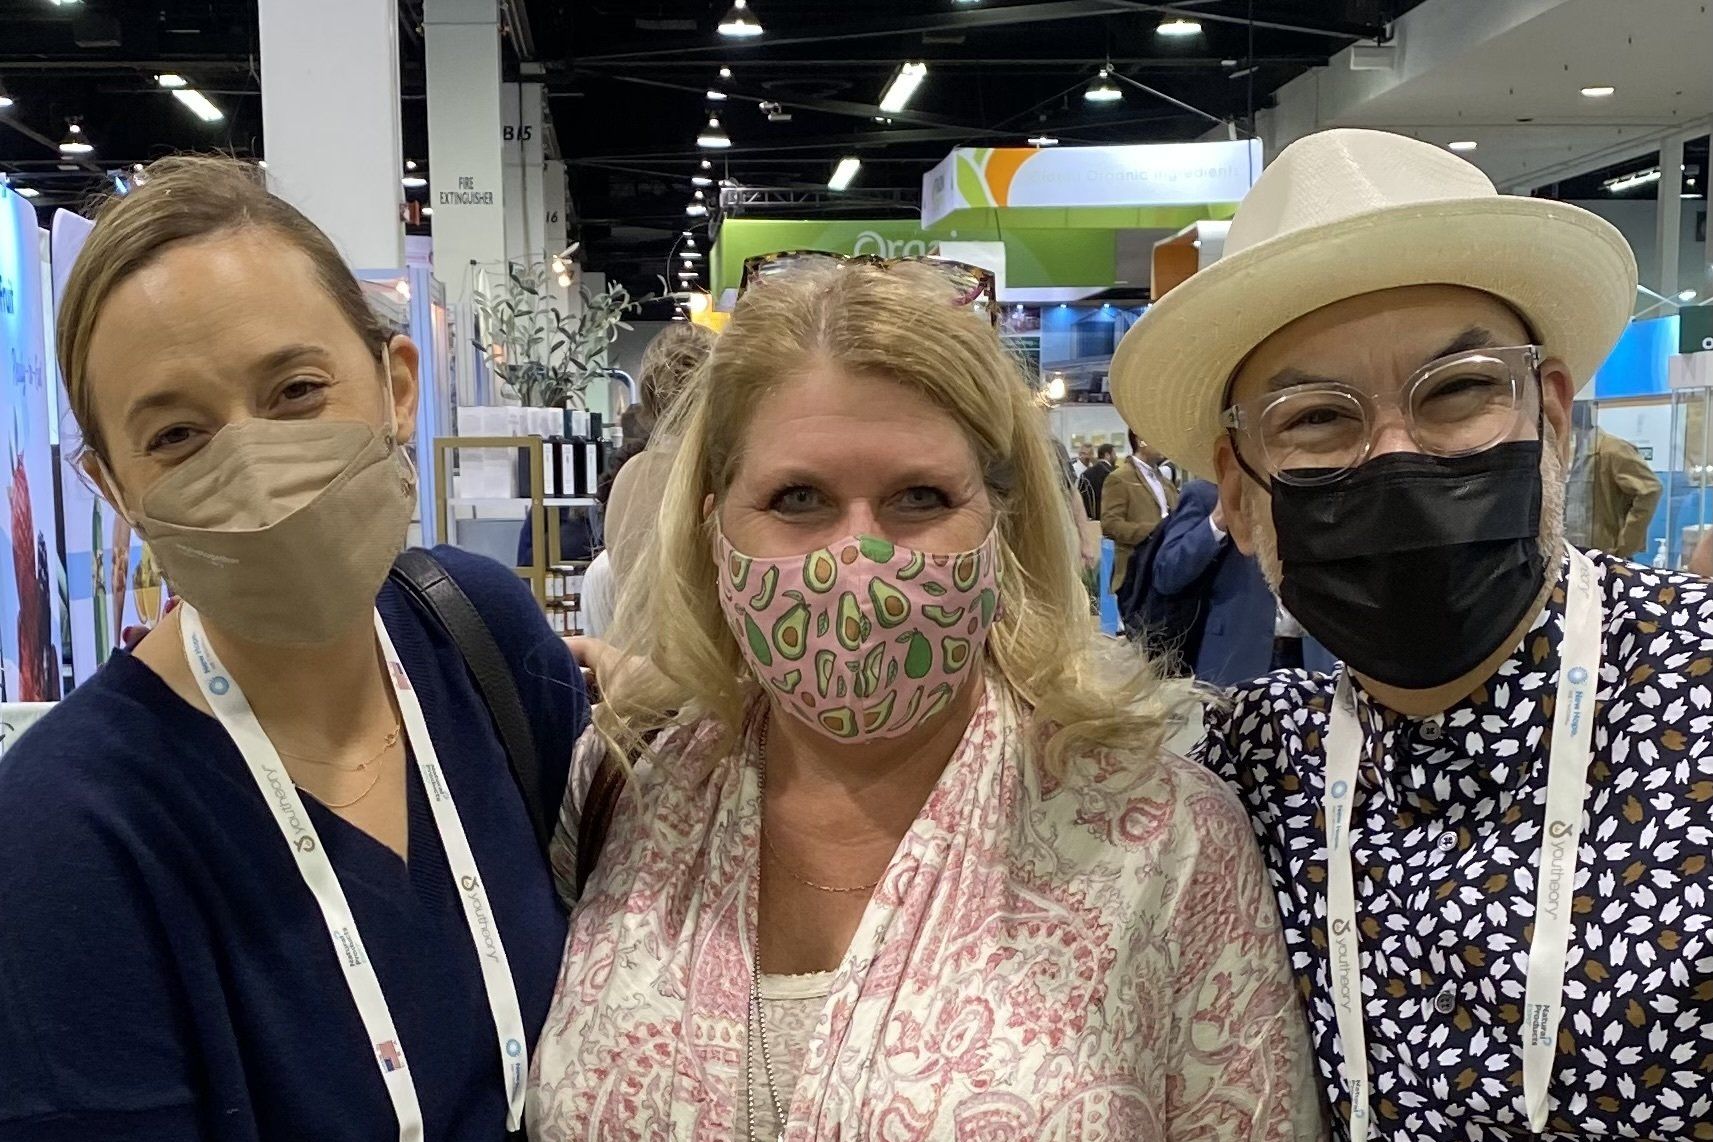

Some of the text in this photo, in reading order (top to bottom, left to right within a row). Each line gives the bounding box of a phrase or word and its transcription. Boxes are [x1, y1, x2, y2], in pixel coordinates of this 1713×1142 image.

[502, 125, 532, 141] B15
[458, 176, 474, 190] FIRE
[1086, 168, 1148, 184] Organic
[439, 191, 494, 205] EXTINGUISHER
[1548, 841, 1564, 920] youtheory
[468, 892, 500, 963] youtheory
[1335, 937, 1352, 1014] youtheory
